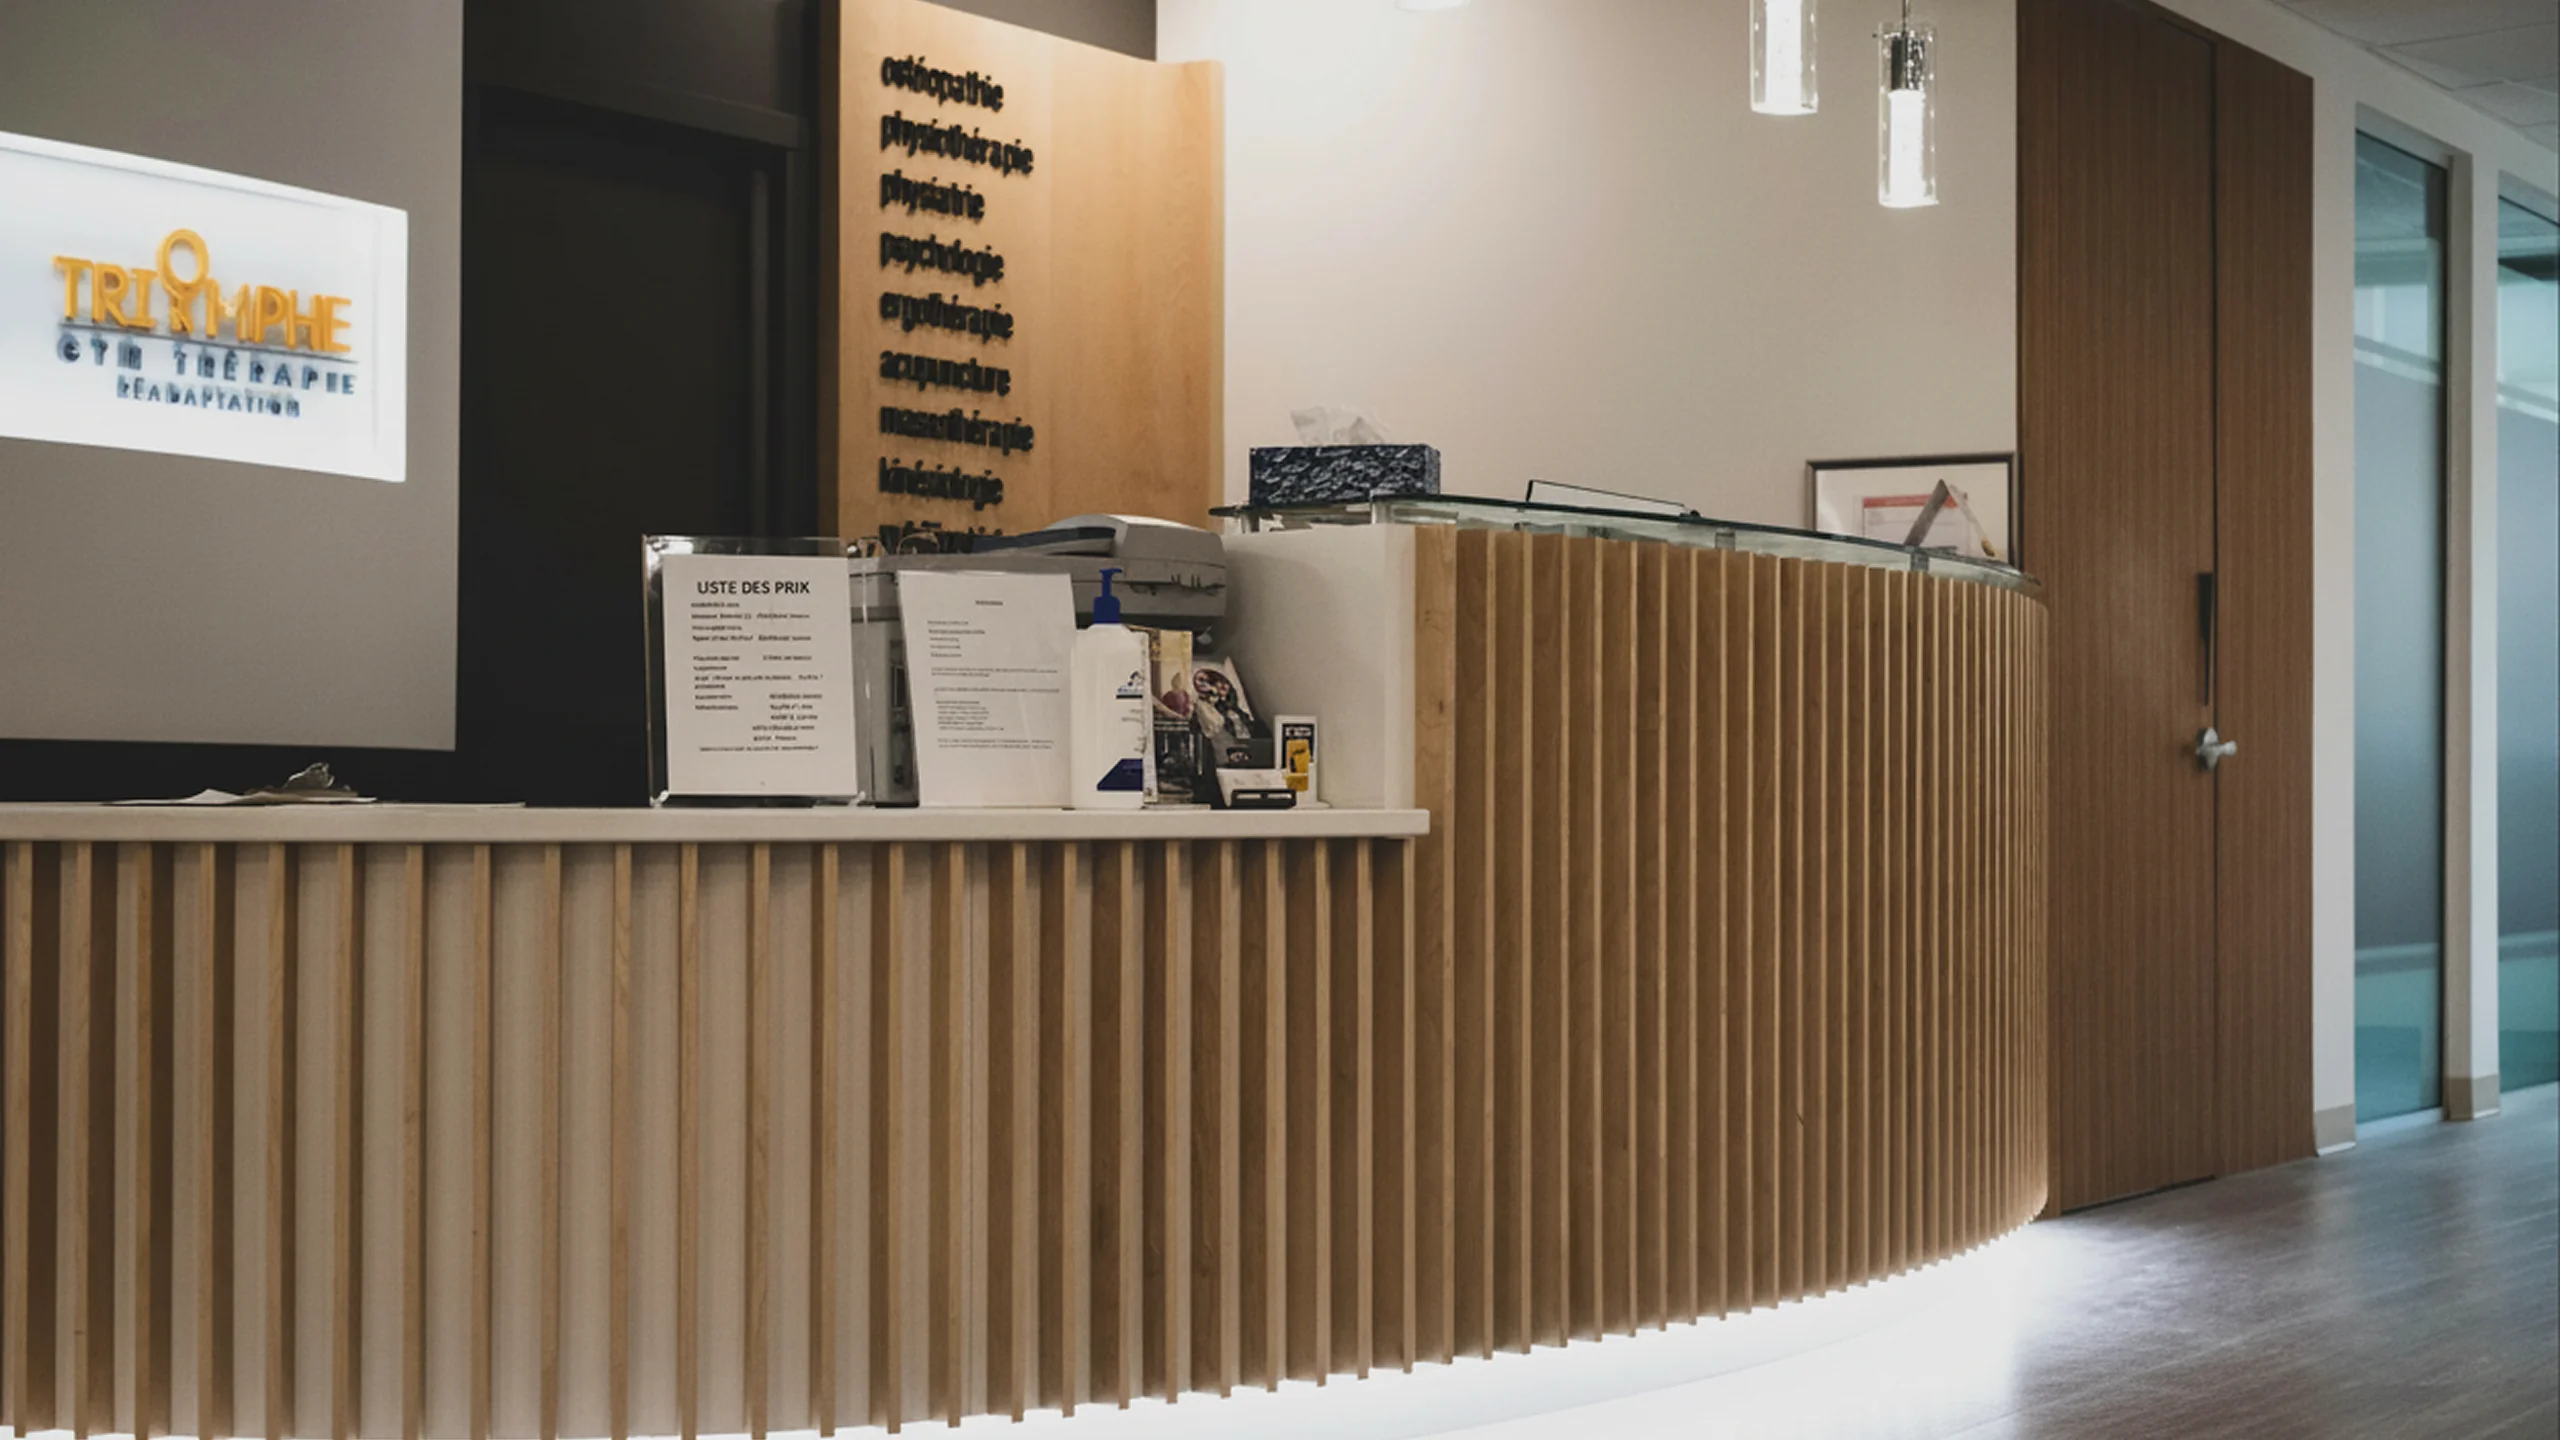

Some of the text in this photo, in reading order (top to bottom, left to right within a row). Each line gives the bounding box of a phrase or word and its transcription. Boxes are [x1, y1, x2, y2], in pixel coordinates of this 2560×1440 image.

[880, 55, 1004, 112] ostéopathie
[879, 110, 1034, 177] physiothérapie
[879, 169, 985, 223] physiatrie
[878, 232, 1005, 288] psychologie
[52, 228, 352, 353] TRIOMPHE
[878, 291, 1015, 345] ergothérapie
[173, 340, 356, 395] THÉRAPIE
[878, 350, 1012, 398] acupuncture
[116, 374, 300, 419] RÉADAPTATION
[878, 405, 1036, 457] massothérapie
[877, 456, 1005, 512] kinésiologie
[741, 580, 772, 595] DES
[774, 580, 810, 595] PRIX
